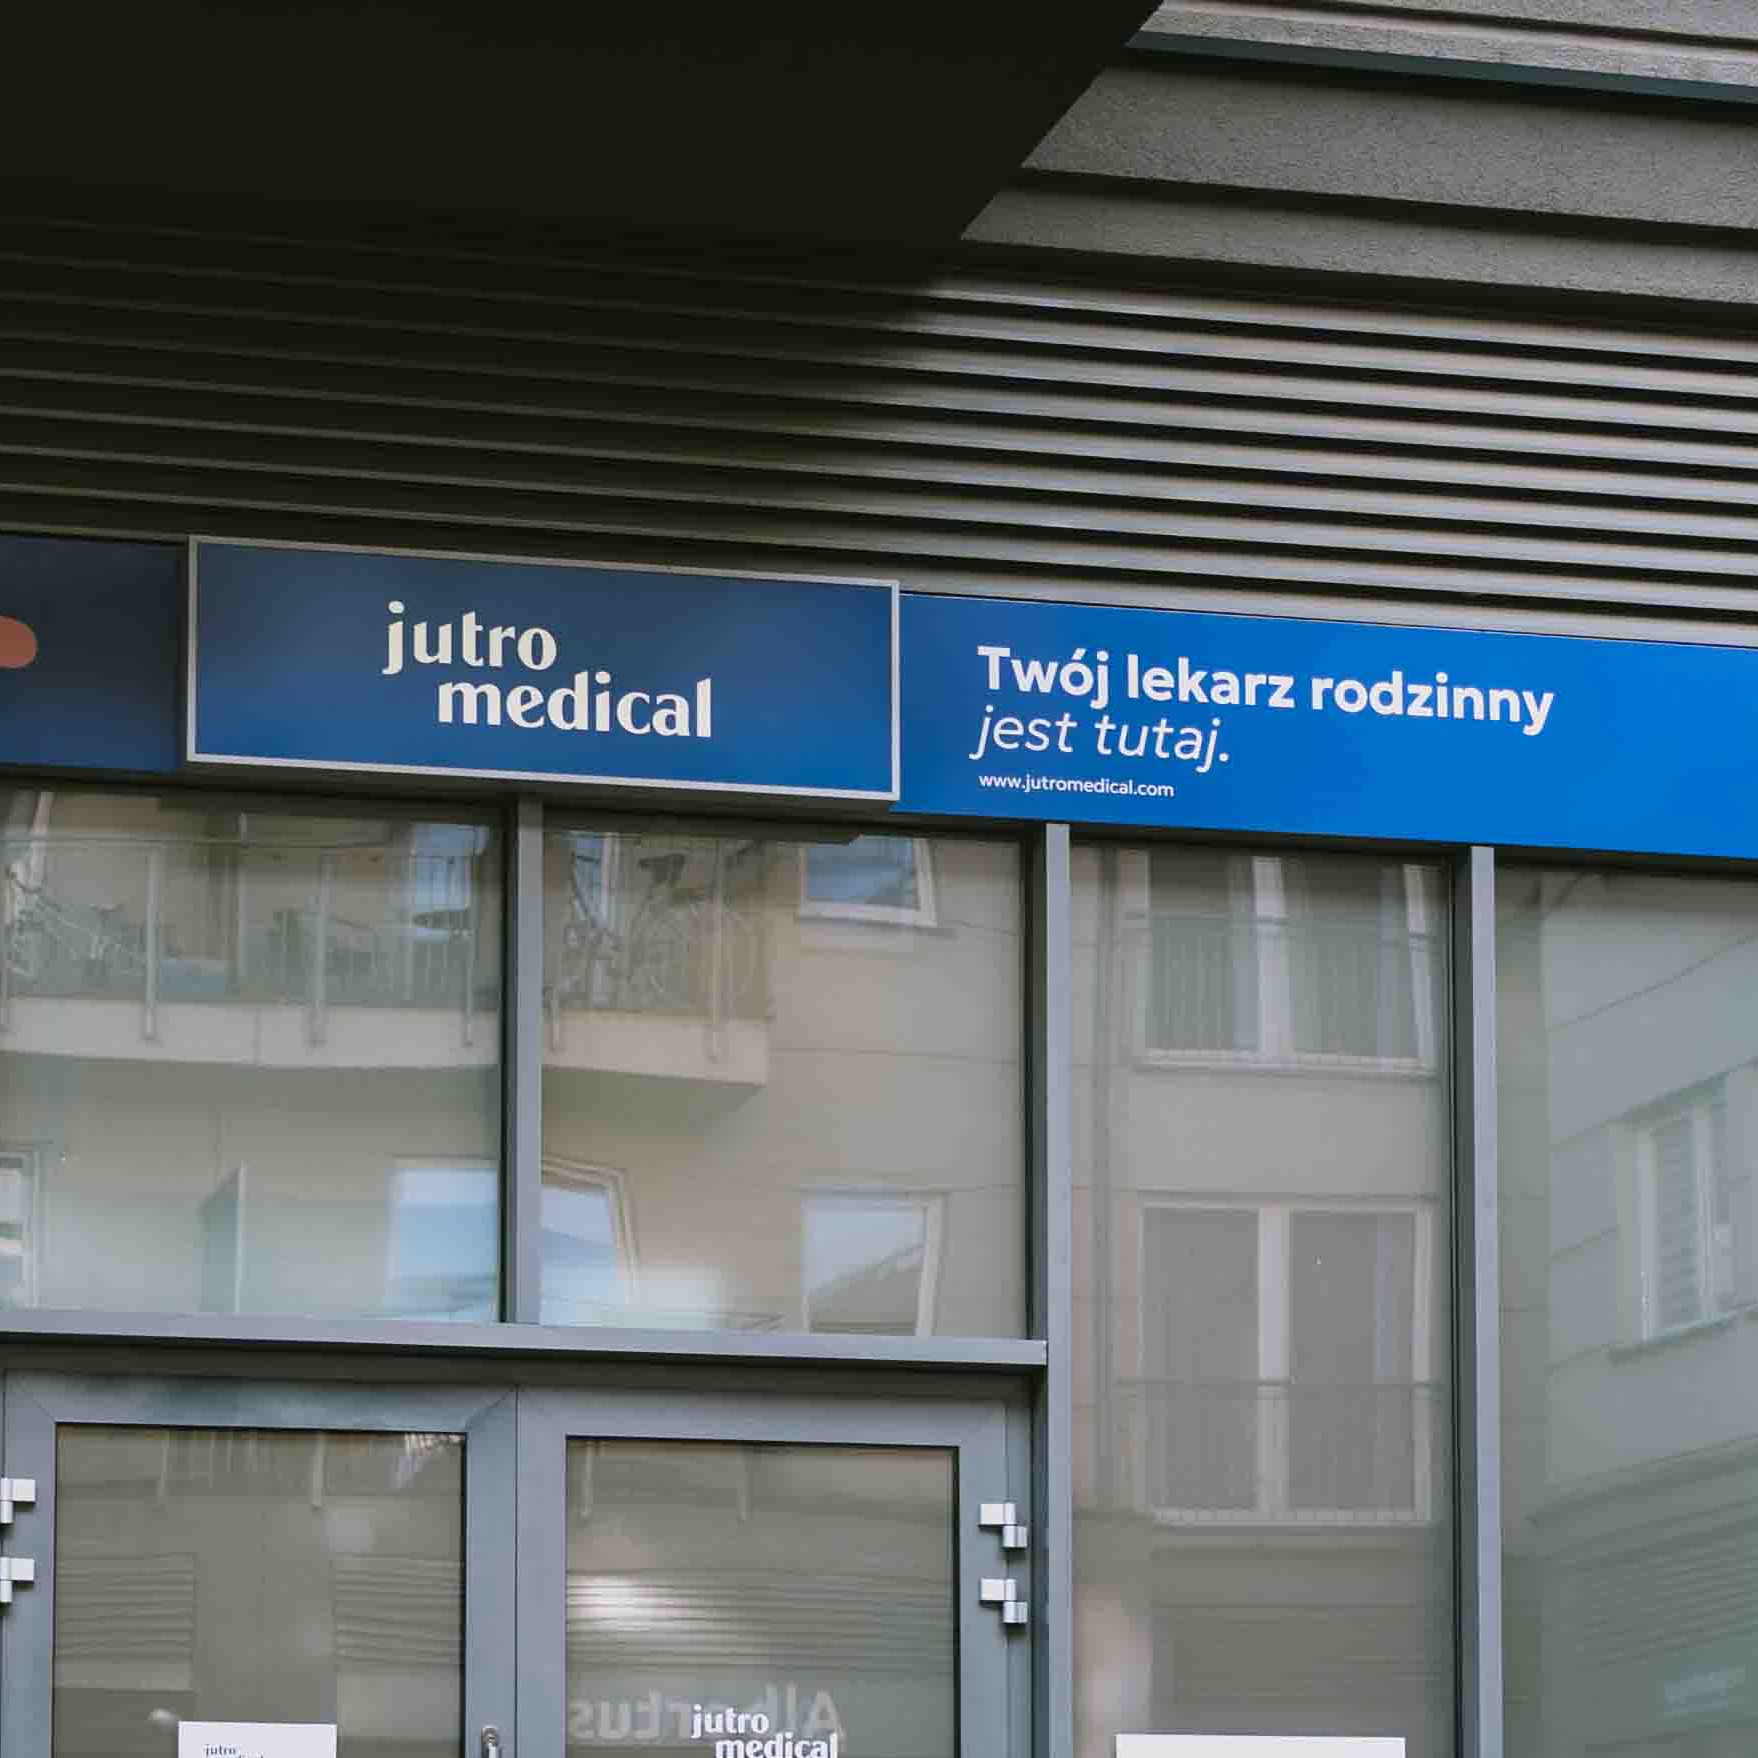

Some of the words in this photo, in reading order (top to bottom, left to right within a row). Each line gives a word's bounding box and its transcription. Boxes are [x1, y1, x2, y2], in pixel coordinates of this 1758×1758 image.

[381, 600, 557, 675] jutro
[438, 670, 712, 738] medical
[976, 645, 1109, 713] Twój
[1127, 653, 1295, 709] lekarz
[1311, 670, 1555, 736] rodzinny
[968, 704, 1078, 760] jest
[1094, 714, 1229, 773] tutaj.
[978, 773, 1175, 797] www.jutromedical.com
[204, 1744, 237, 1758] jutro
[691, 1704, 769, 1738] jutro
